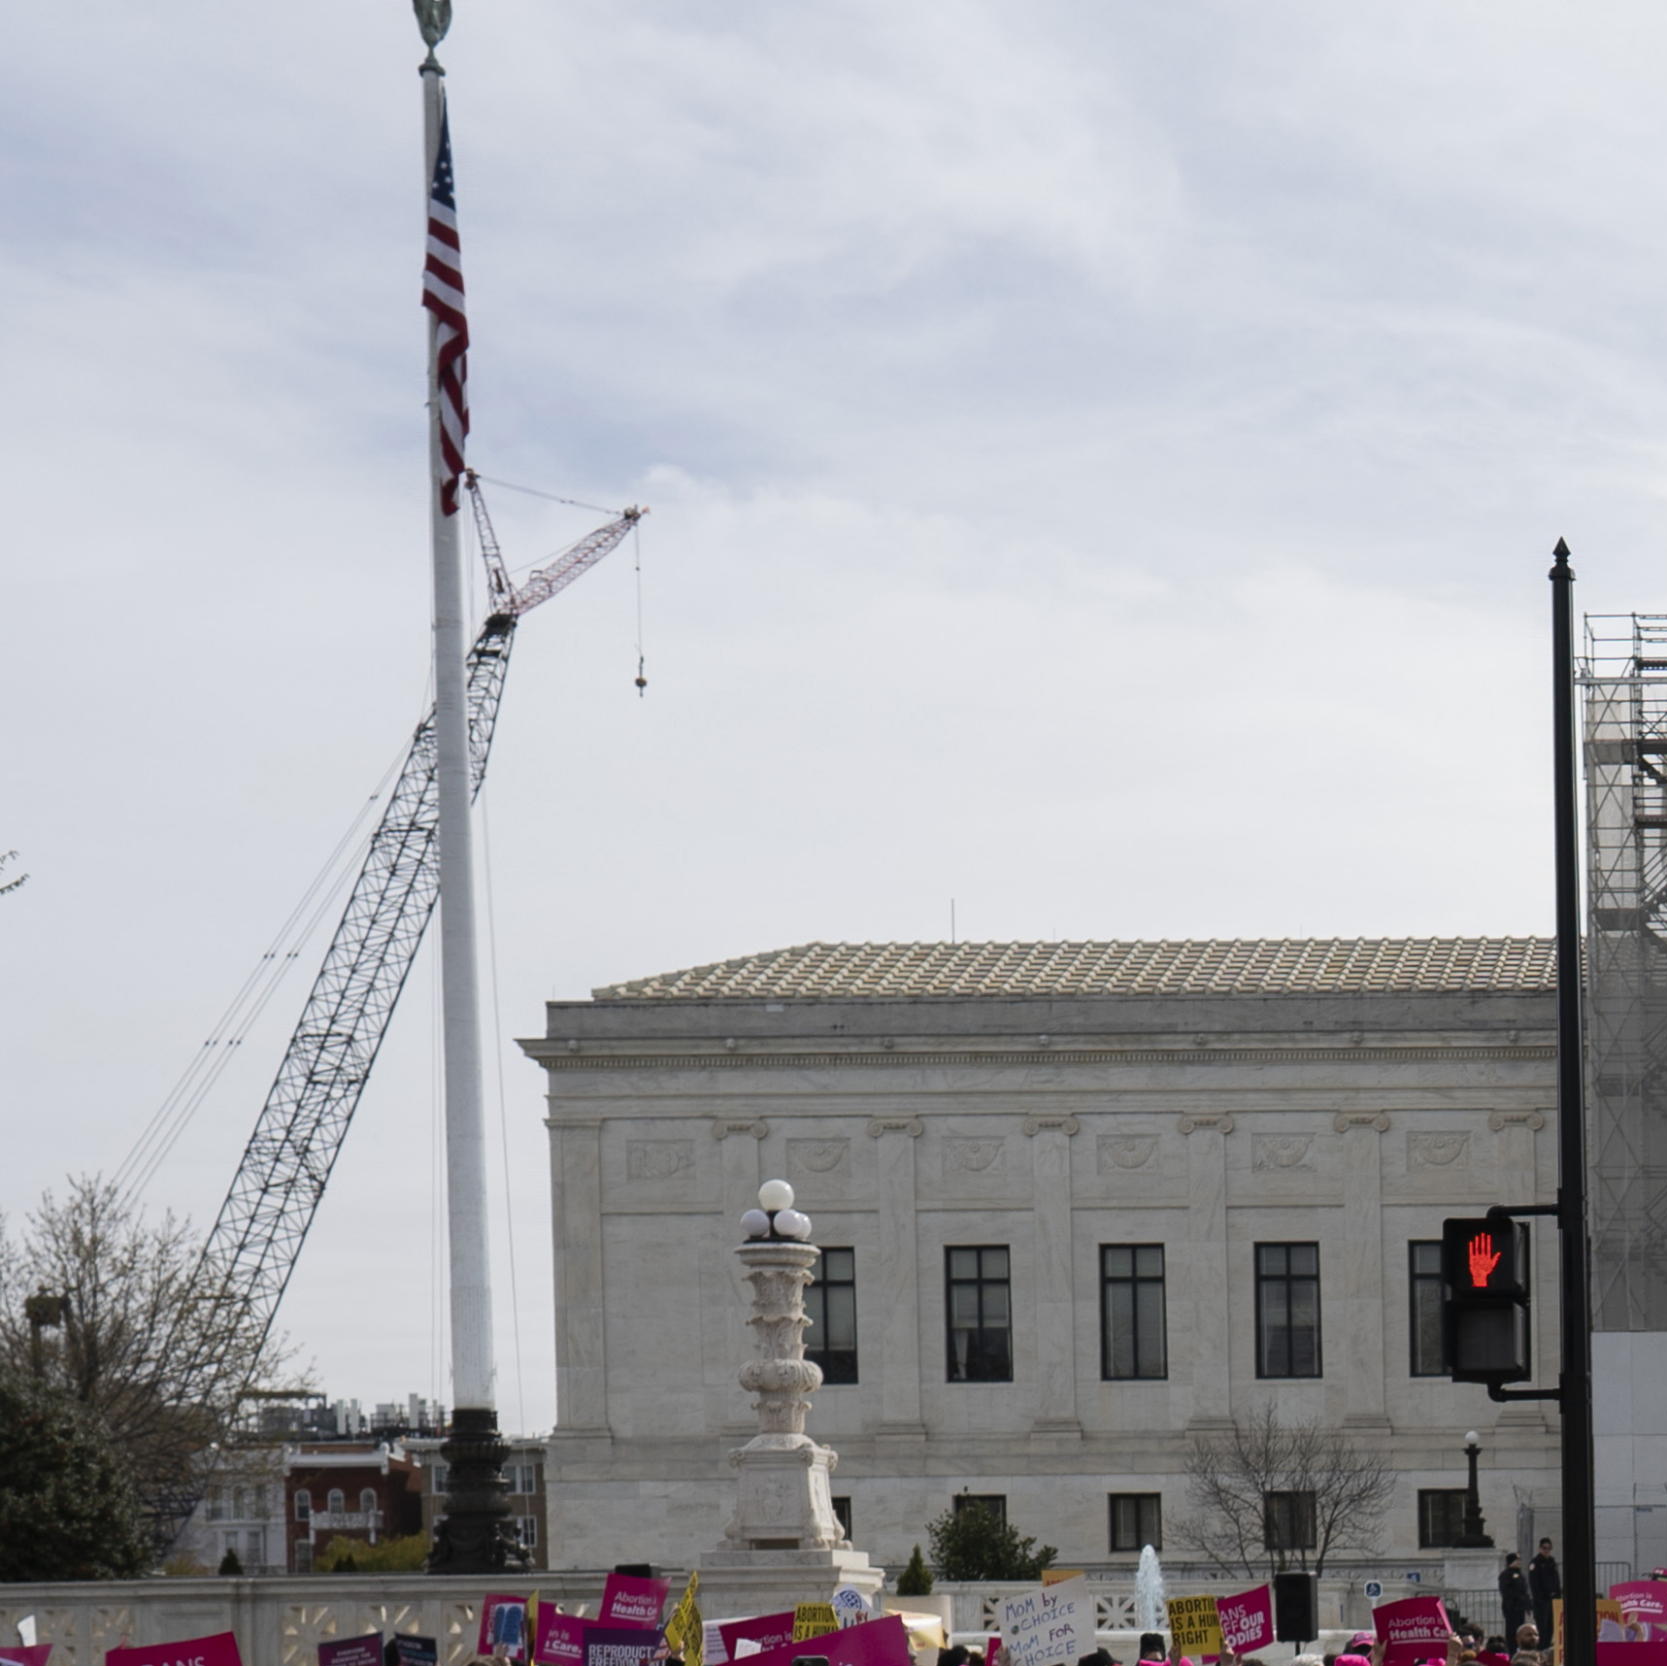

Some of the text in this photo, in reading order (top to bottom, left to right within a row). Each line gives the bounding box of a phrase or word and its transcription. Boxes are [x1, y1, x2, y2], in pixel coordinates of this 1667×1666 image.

[1006, 1593, 1057, 1621] MOM by
[1021, 1602, 1075, 1631] CHOICE
[1240, 1612, 1265, 1628] OUR
[1049, 1624, 1074, 1641] FOR
[1173, 1631, 1209, 1646] RIGHT
[552, 1640, 582, 1654] Care.
